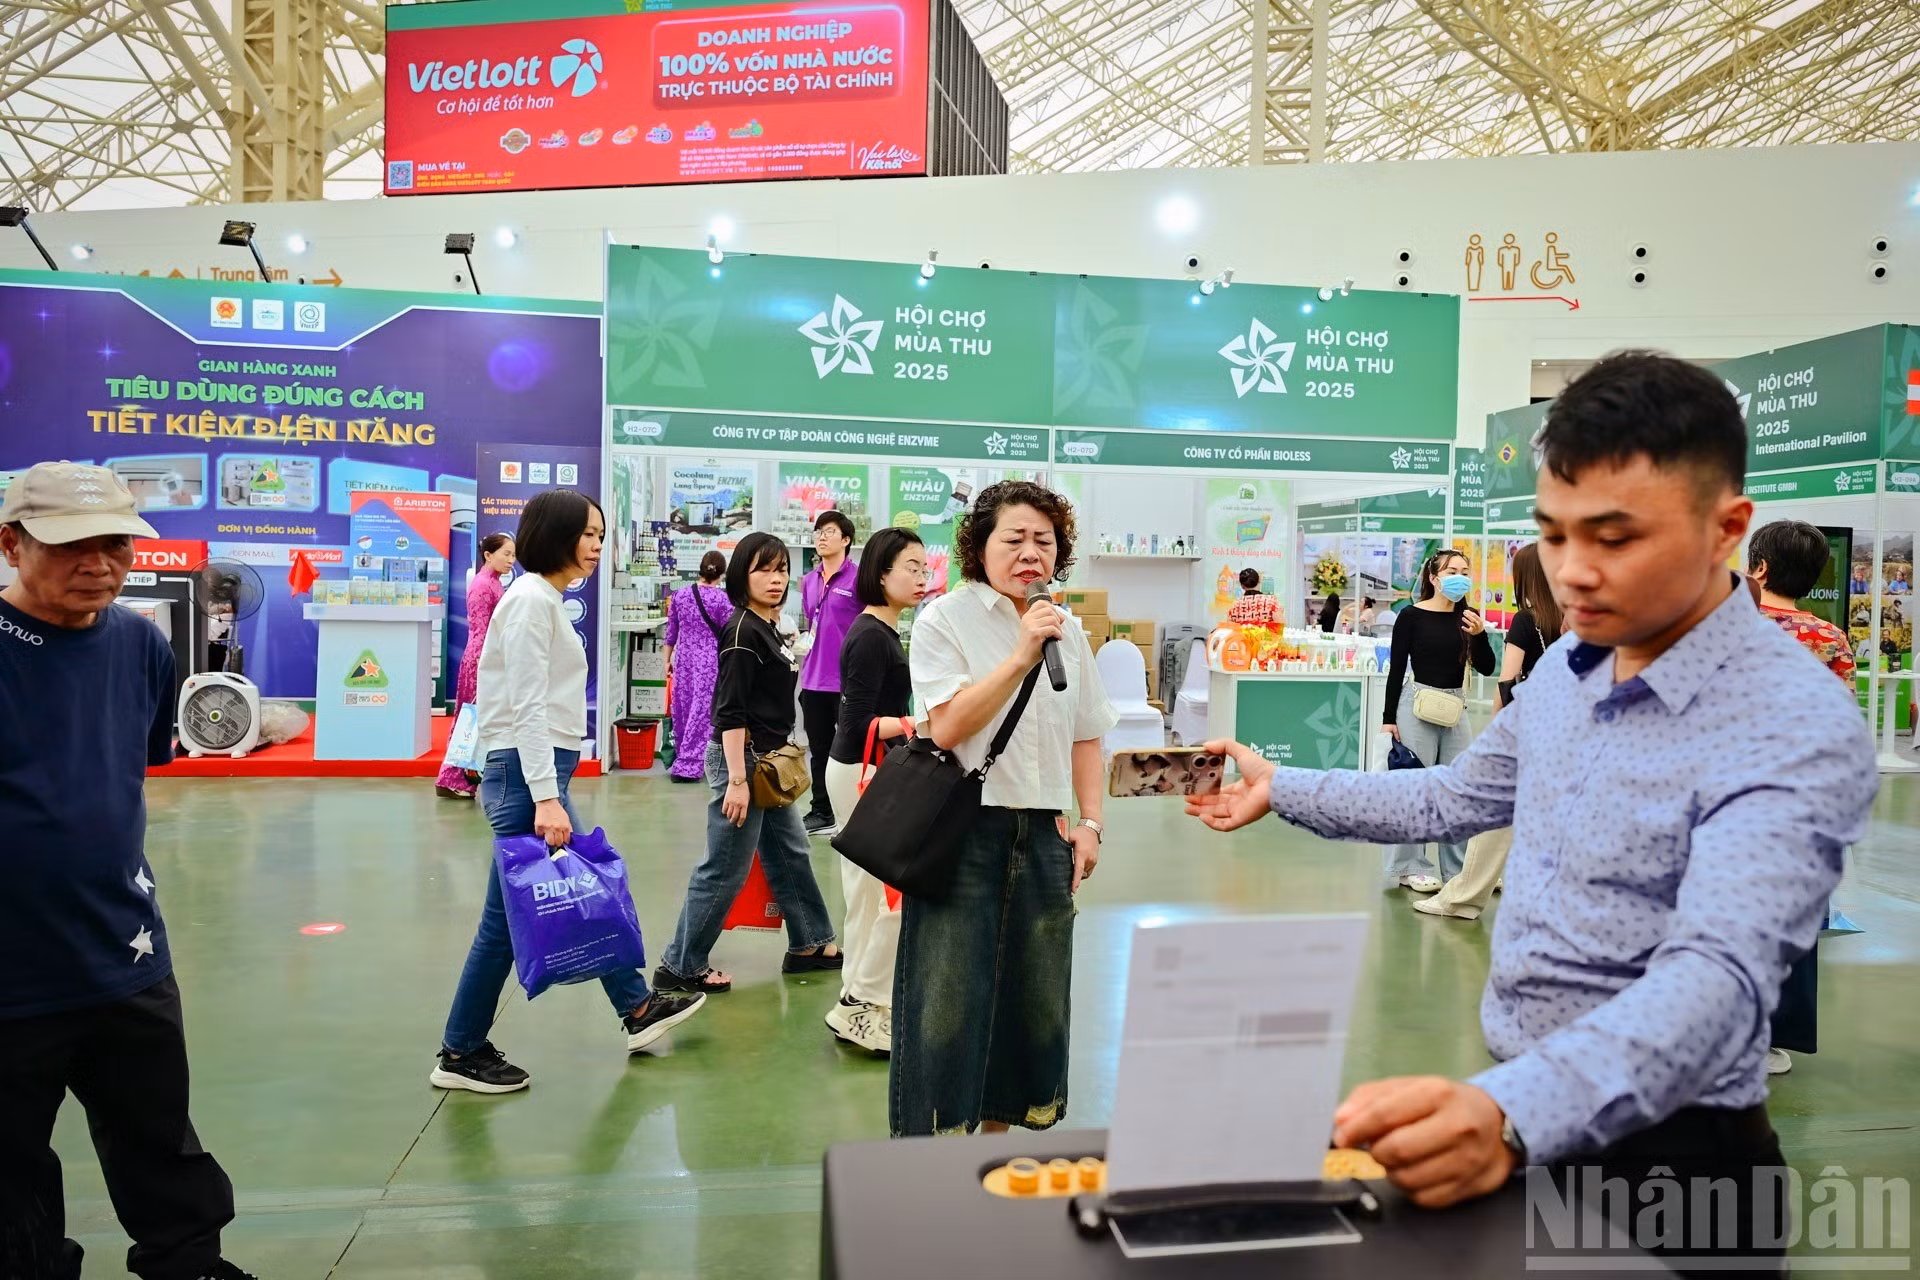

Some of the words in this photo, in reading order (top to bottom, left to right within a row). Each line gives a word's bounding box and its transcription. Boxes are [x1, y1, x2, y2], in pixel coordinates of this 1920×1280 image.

[698, 28, 771, 47] DOANH
[776, 19, 852, 43] NGHIỆP
[659, 52, 730, 77] 100%
[734, 50, 778, 72] VỐN
[783, 48, 828, 69] NHÀ
[833, 45, 893, 67] NƯỚC
[408, 56, 543, 93] Vietlott
[659, 82, 704, 101] TRỰC
[708, 76, 769, 97] THUỘC
[773, 74, 799, 94] BỘ
[803, 72, 831, 90] TÀI
[835, 69, 893, 89] CHÍNH
[436, 98, 456, 115] Cơ
[457, 97, 480, 116] hội
[483, 94, 502, 112] để
[503, 94, 523, 111] tốt
[526, 95, 554, 110] hơn
[895, 303, 933, 329] HỘI
[939, 309, 986, 333] CHỢ
[895, 330, 943, 353] MÙA
[948, 337, 992, 356] THU
[1306, 325, 1341, 350] HỘI
[1345, 330, 1389, 352] CHỢ
[198, 359, 239, 373] GIAN
[243, 359, 288, 376] HÀNG
[292, 363, 337, 378] XANH
[894, 362, 949, 381] 2025
[1306, 351, 1349, 372] MÙA
[1354, 357, 1394, 374] THU
[1305, 381, 1355, 398] 2025
[1757, 373, 1781, 395] HỘI
[1783, 366, 1815, 388] CHỢ
[105, 374, 170, 400] TIÊU
[176, 377, 257, 404] DÙNG
[262, 381, 344, 408] ĐÚNG
[349, 385, 424, 411] CÁCH
[1757, 395, 1787, 415] MÙA
[1789, 391, 1818, 410] THU
[87, 405, 157, 435] TIẾT
[166, 409, 245, 443] KIỆM
[346, 416, 436, 446] NĂNG
[1755, 419, 1790, 438] 2025
[712, 424, 744, 439] CÔNG
[746, 427, 761, 439] TY
[762, 428, 777, 440] CP
[779, 427, 799, 442] TẬP
[801, 427, 832, 443] ĐOÀN
[834, 430, 864, 444] CÔNG
[867, 431, 896, 447] NGHỆ
[897, 434, 940, 448] ENZYME
[1755, 436, 1820, 456] International
[1822, 431, 1867, 447] Pavilion
[1183, 445, 1212, 459] CÔNG
[1214, 448, 1226, 459] TY
[1228, 445, 1242, 460] CỔ
[1244, 447, 1271, 461] PHẦN
[1273, 450, 1311, 462] BIOLESS
[1461, 461, 1479, 474] HỘI
[785, 475, 862, 489] VINATTO
[899, 478, 945, 493] NHÀU
[1460, 473, 1482, 485] MÙA
[1747, 483, 1777, 495] INSTITUTE
[1777, 481, 1798, 493] GMBH
[481, 496, 496, 505] CÁC
[814, 491, 861, 501] ENZYME
[903, 493, 940, 502] ENZYME
[1460, 488, 1485, 498] 2025
[404, 500, 446, 508] ARISTON
[1460, 500, 1485, 508] Interna
[217, 523, 240, 533] ĐƠN
[241, 525, 253, 536] VỊ
[255, 523, 285, 535] ĐỒNG
[287, 524, 317, 536] HÀNH
[133, 575, 152, 584] TIẾP
